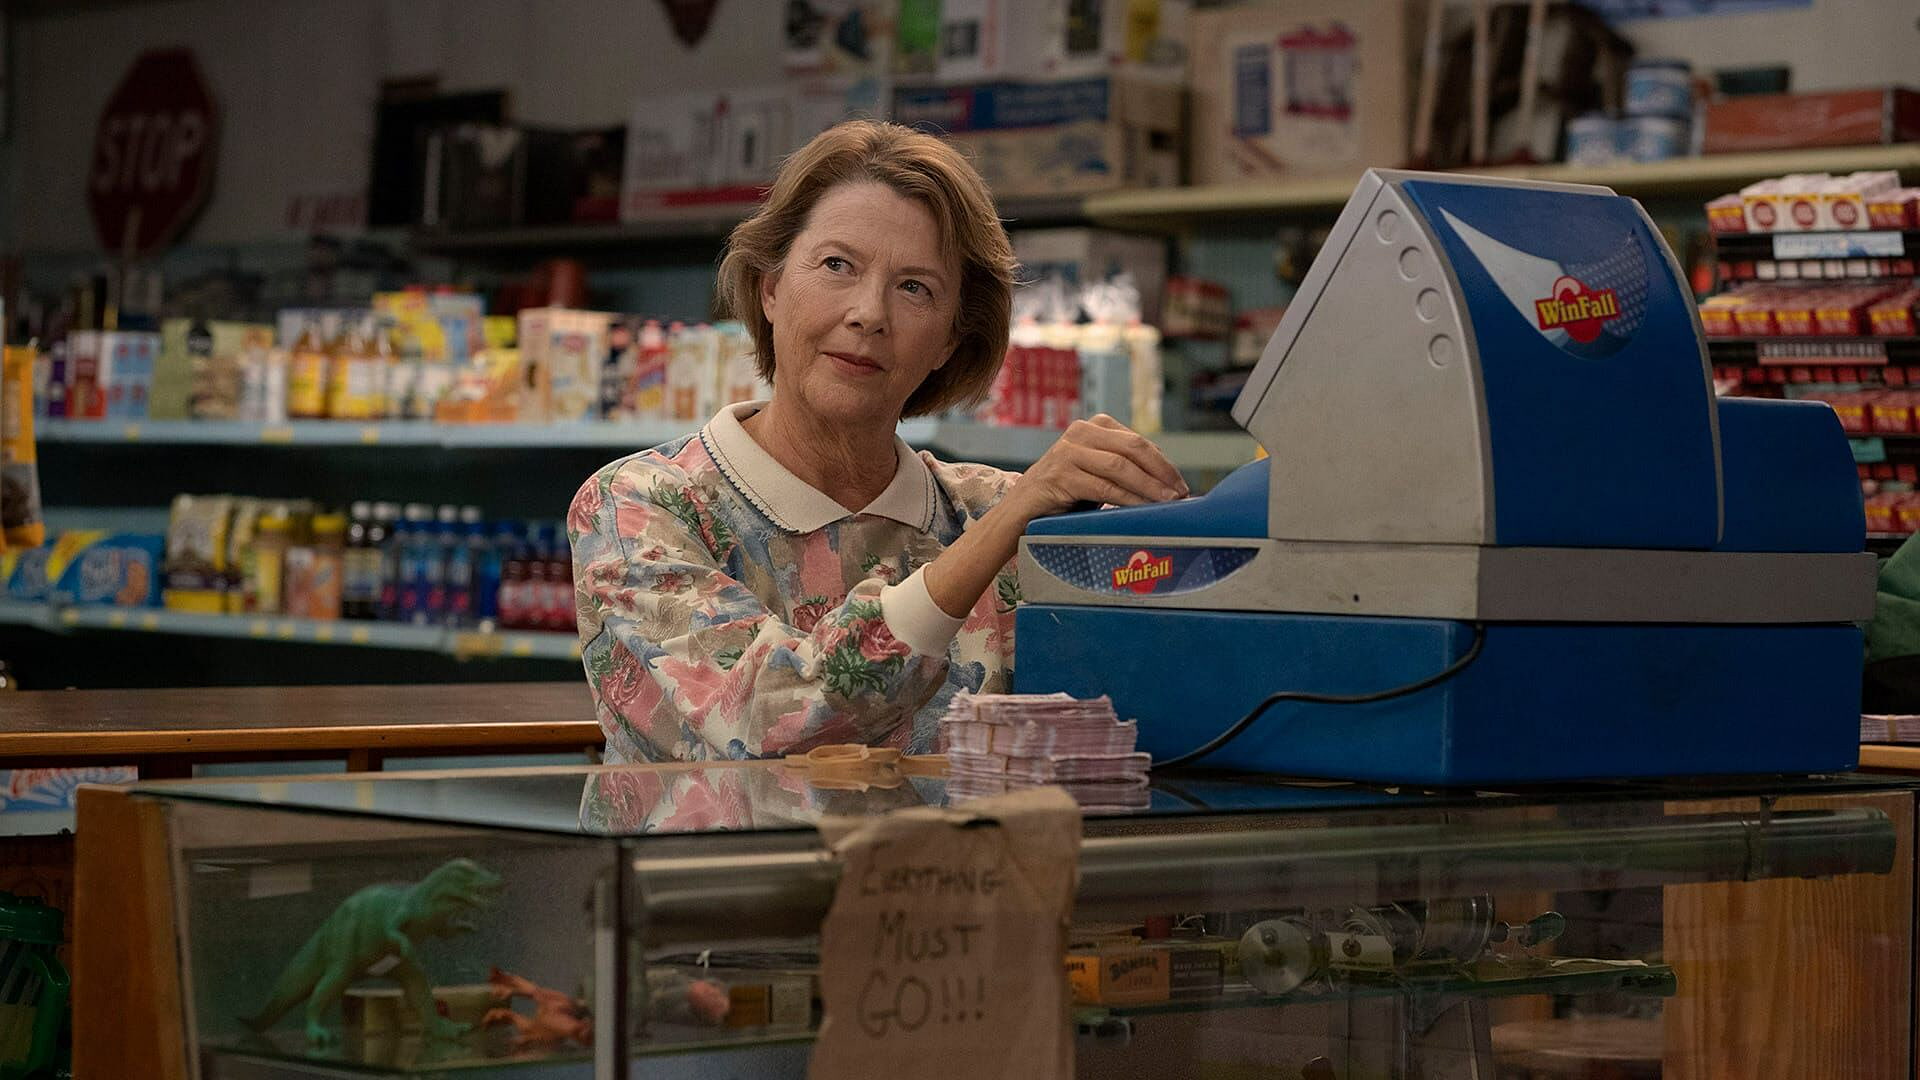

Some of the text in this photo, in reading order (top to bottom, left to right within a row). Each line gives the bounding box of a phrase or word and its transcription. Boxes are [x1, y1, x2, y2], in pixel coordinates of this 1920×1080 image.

[97, 112, 202, 193] STOP
[1538, 293, 1616, 325] WinFall
[1115, 560, 1169, 586] WinFall
[873, 910, 983, 963] MUST
[857, 969, 985, 1038] GO!!!
